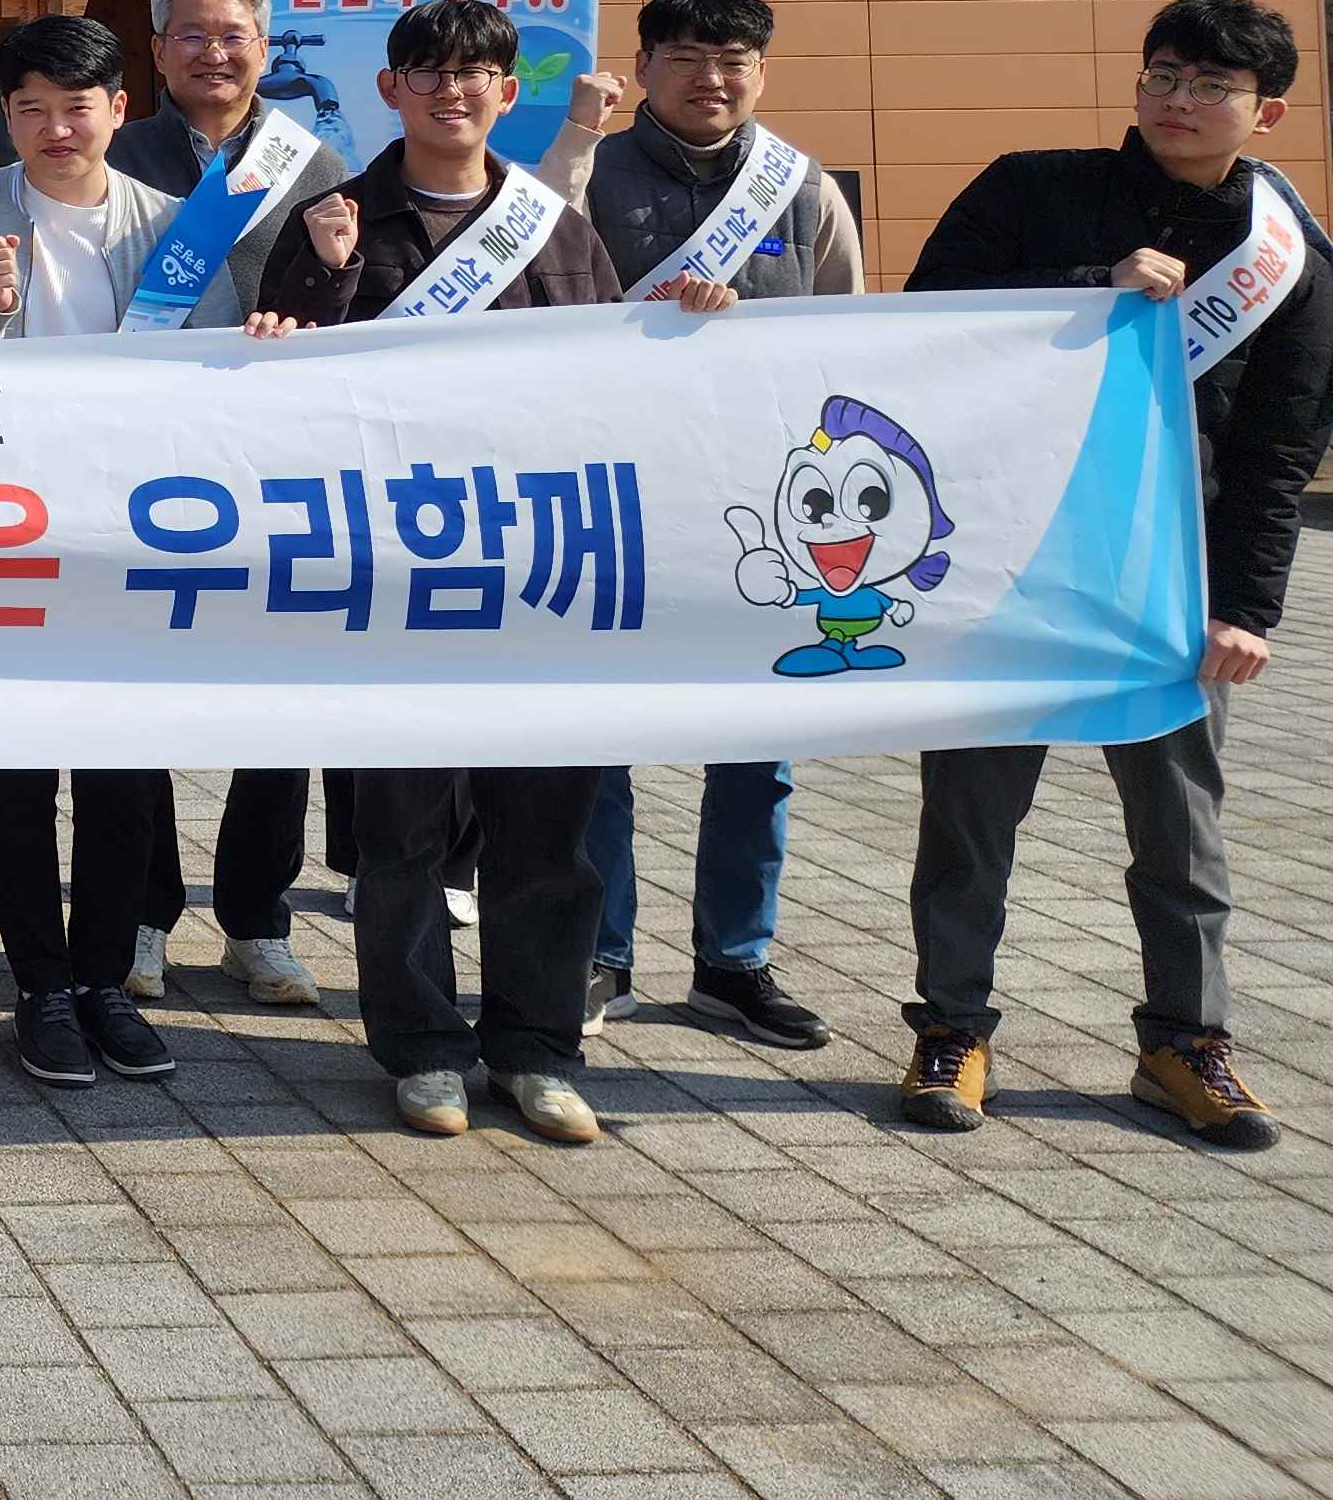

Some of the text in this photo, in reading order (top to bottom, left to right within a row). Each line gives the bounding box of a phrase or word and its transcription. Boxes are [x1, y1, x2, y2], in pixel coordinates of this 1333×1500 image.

[478, 186, 547, 267] 생명을
[680, 136, 798, 281] 생명을 살리는
[1188, 240, 1288, 339] 절약은
[125, 462, 646, 632] 우리함께
